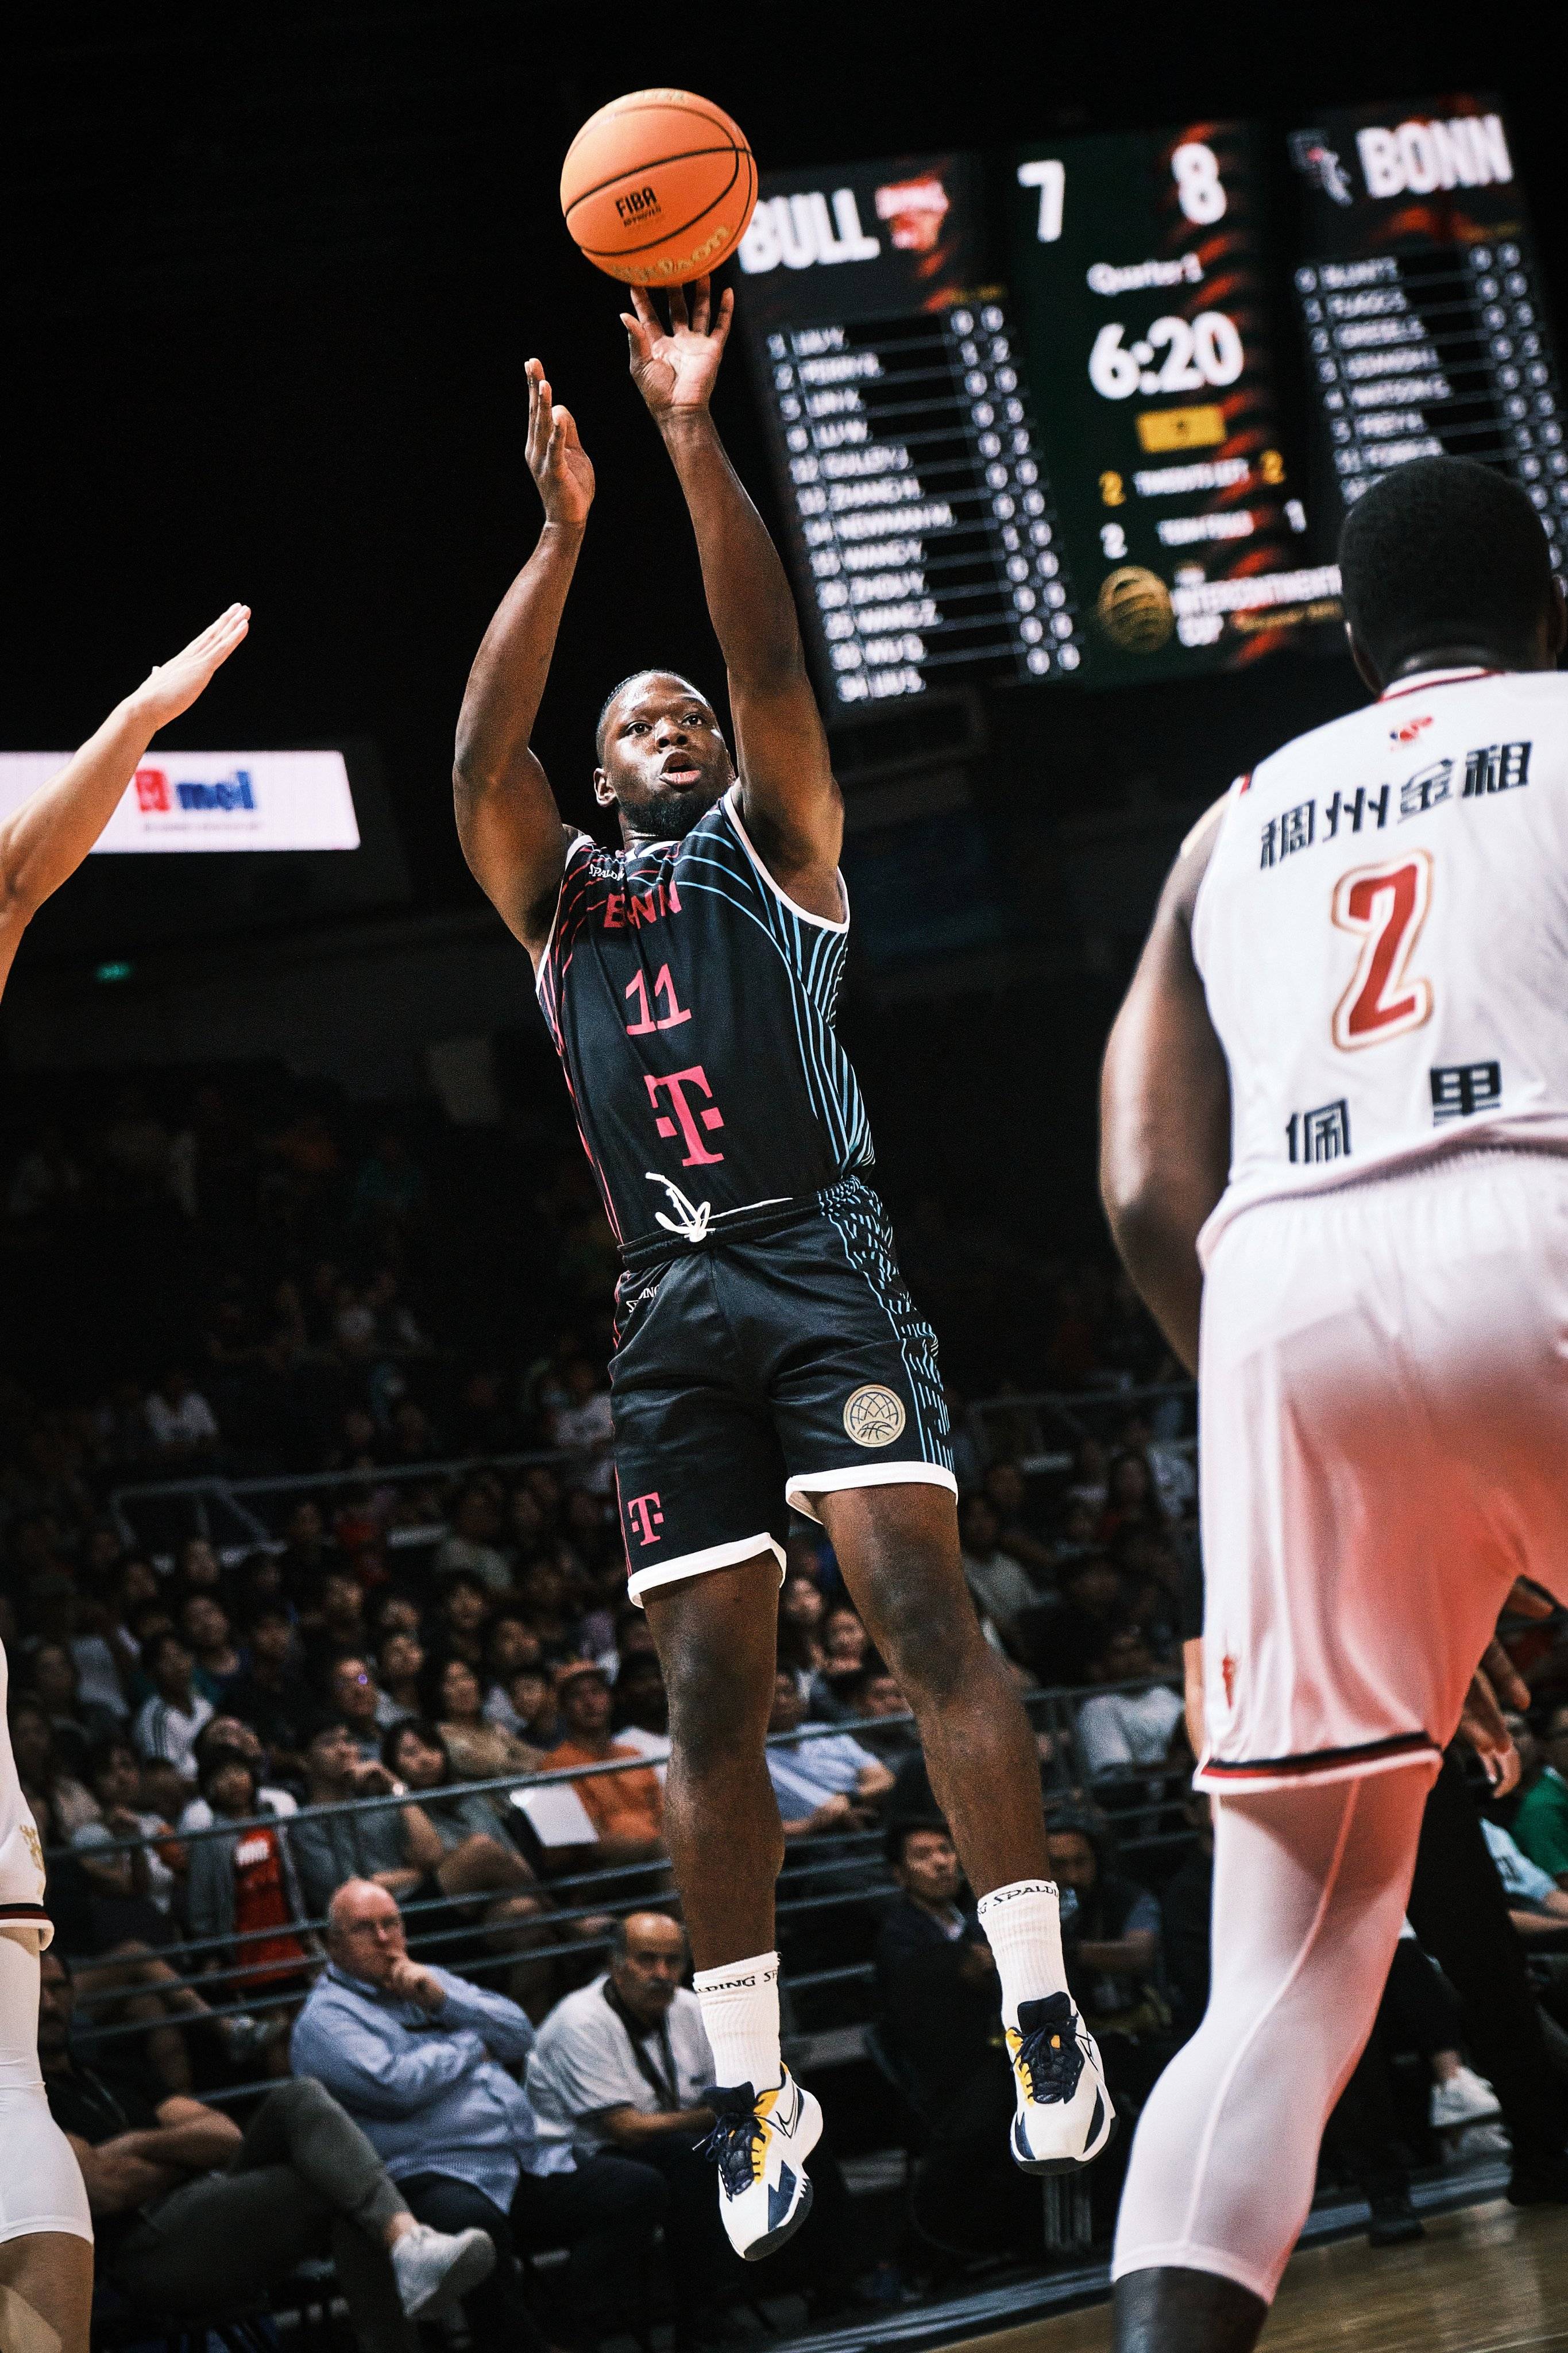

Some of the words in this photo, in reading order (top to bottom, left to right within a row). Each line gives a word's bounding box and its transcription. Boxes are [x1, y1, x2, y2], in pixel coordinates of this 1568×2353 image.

[1171, 142, 1227, 224] 8
[1356, 114, 1513, 199] BONN
[615, 187, 657, 217] FIBA
[737, 188, 880, 274] BULL
[1018, 159, 1065, 242] 7
[1089, 311, 1244, 400] 6:20
[1337, 854, 1428, 1047] 2
[626, 963, 692, 1035] 11
